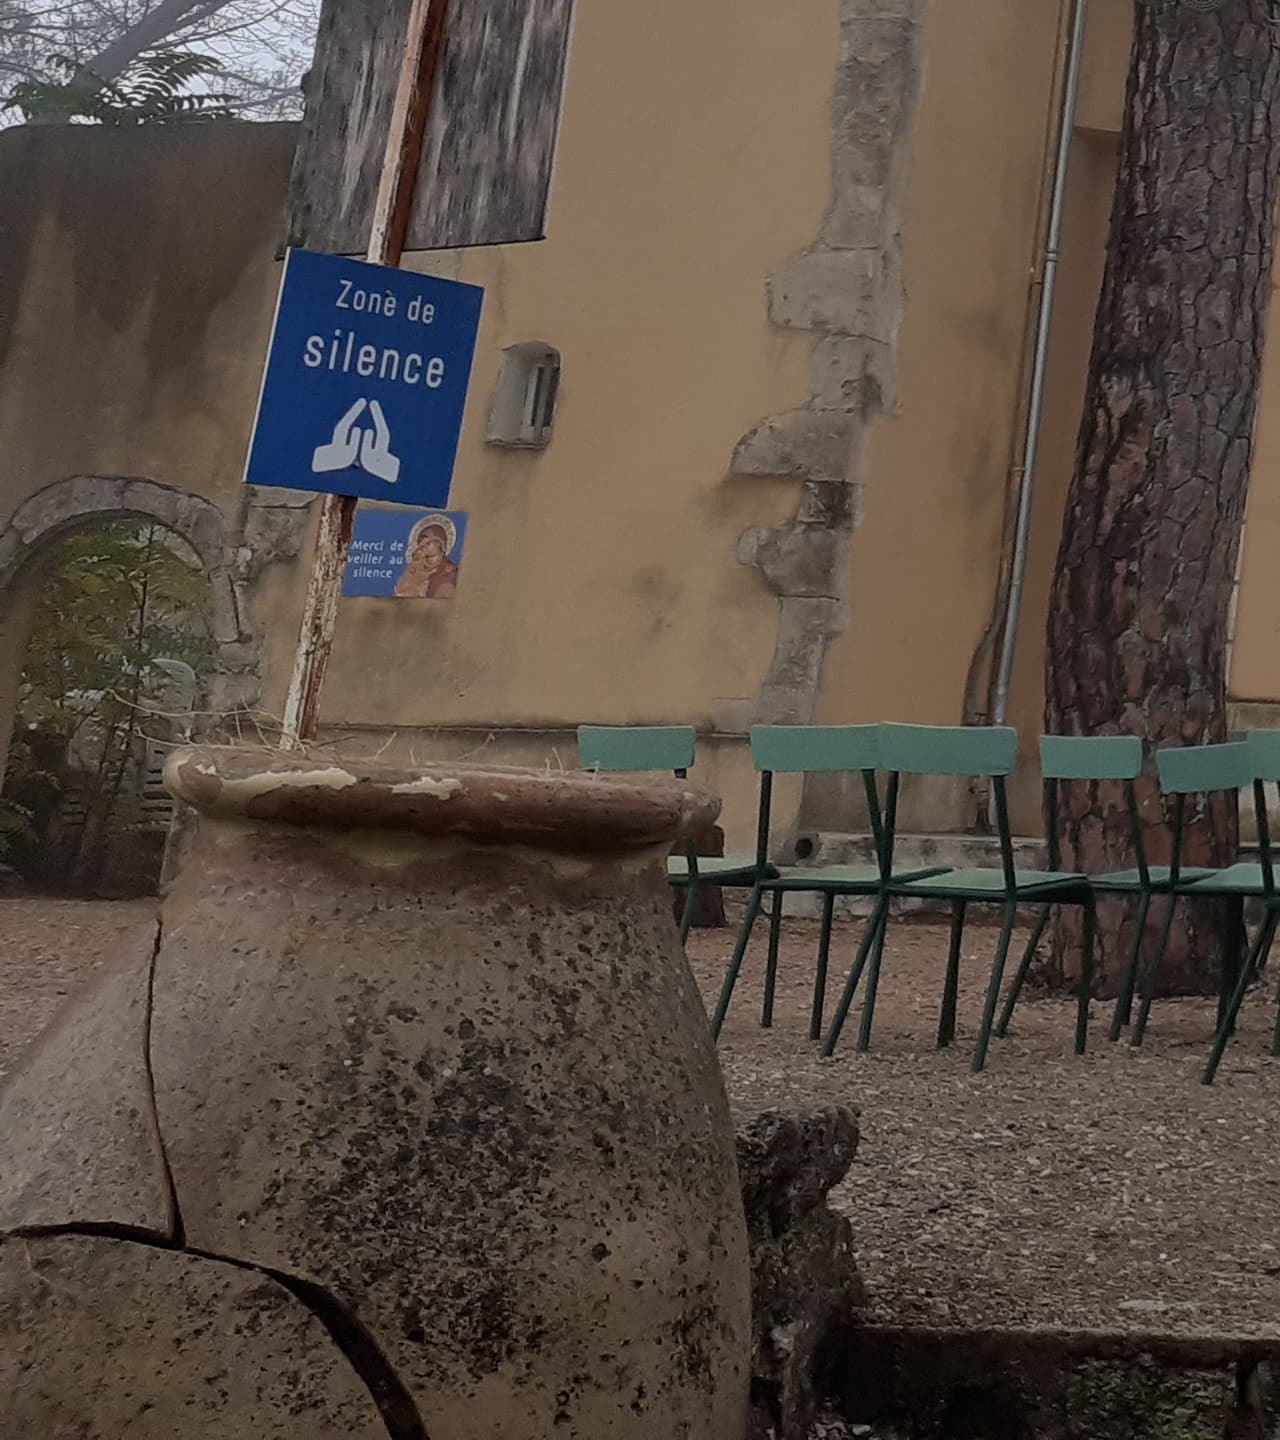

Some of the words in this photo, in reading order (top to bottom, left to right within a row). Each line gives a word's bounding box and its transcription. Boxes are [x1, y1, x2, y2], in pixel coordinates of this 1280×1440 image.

[336, 280, 397, 317] Zone
[407, 294, 435, 324] de
[303, 329, 445, 389] silence
[351, 539, 384, 551] Merci
[390, 539, 404, 551] de
[347, 553, 384, 564] veiller
[389, 556, 404, 565] au
[353, 566, 393, 578] silence
